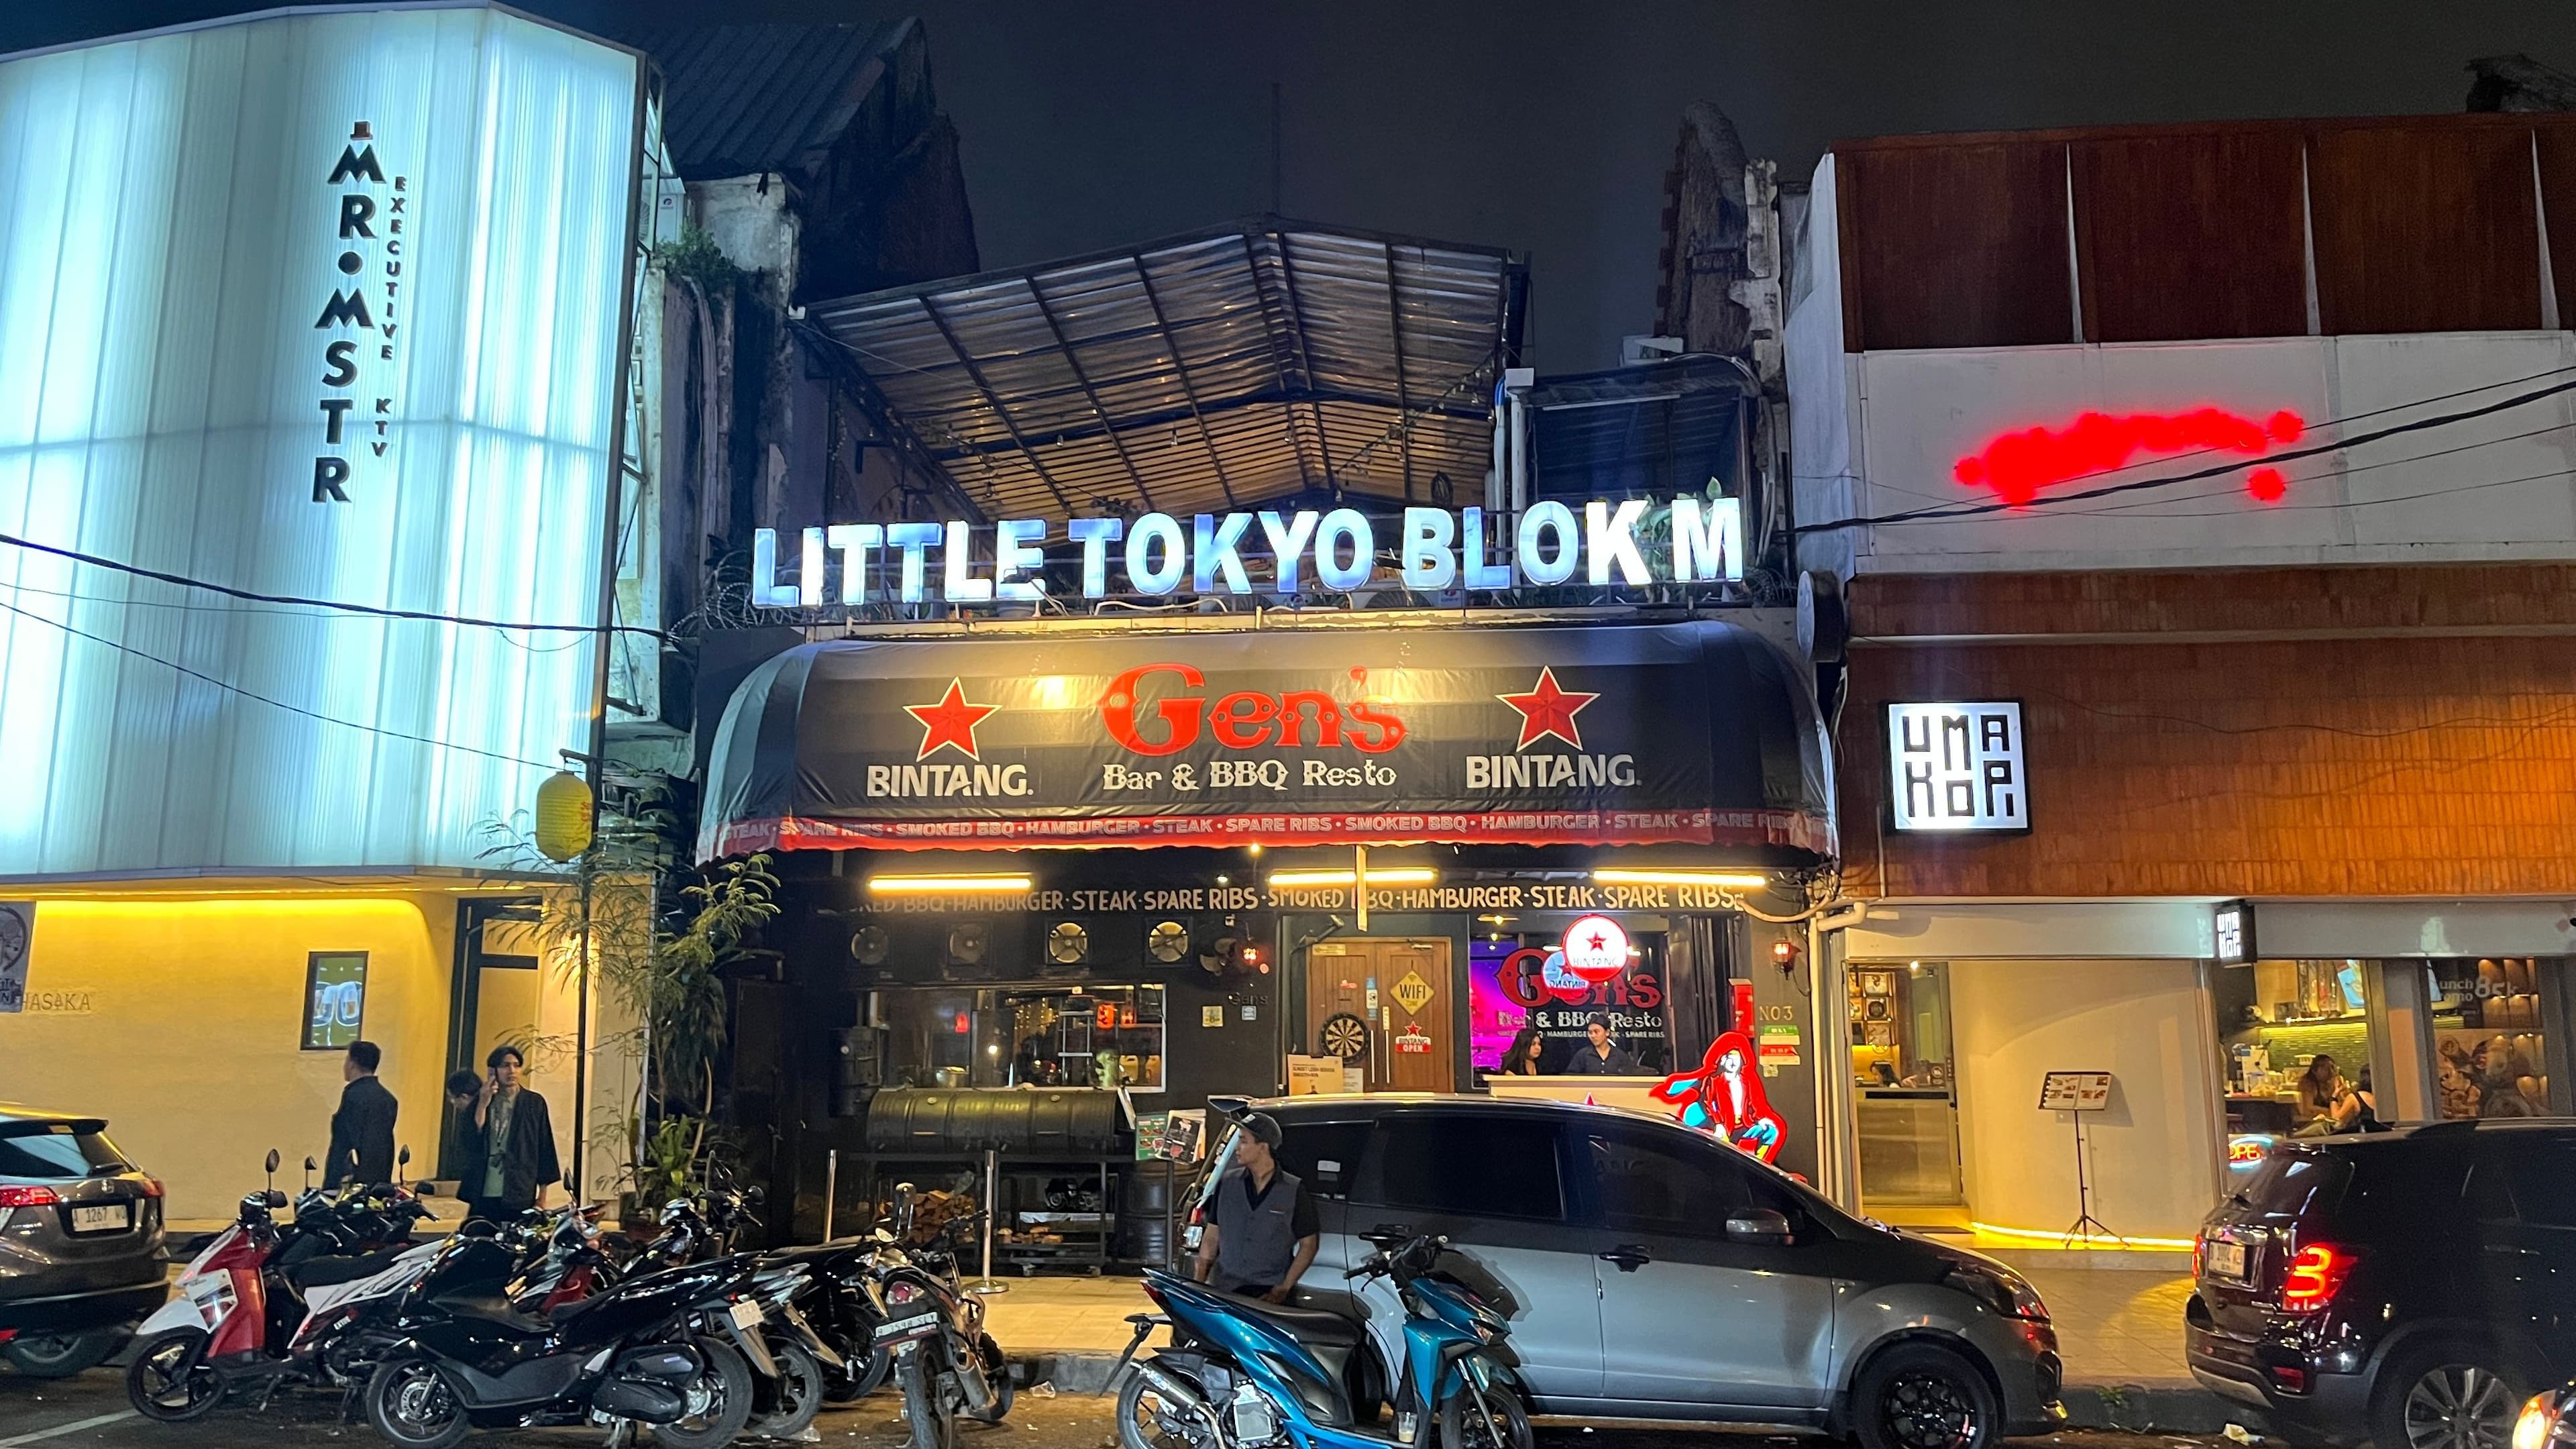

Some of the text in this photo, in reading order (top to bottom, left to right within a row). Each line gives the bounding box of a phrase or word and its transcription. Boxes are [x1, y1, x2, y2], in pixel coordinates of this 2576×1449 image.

[371, 175, 407, 457] EXECUTIVE KTV
[751, 497, 1743, 608] LITTLE TOKYO BLOK M
[1097, 662, 1409, 757] Gen's
[1902, 714, 2010, 771] UMA
[1103, 759, 1397, 792] Bar & BBQ Resto
[779, 821, 839, 837] SPARE
[841, 822, 883, 837] RIBS
[895, 822, 973, 838] SMOKED
[976, 822, 1015, 839] BBQ
[1026, 819, 1141, 836] HAMBURGER
[1152, 818, 1214, 835] STEAK
[1225, 817, 1286, 833] SPARE
[1289, 817, 1333, 833] RIBS
[1344, 816, 1424, 832] SMOKED
[1428, 815, 1468, 834] BBQ
[1481, 814, 1601, 830] HAMBURGER
[1614, 813, 1679, 829] STEAK
[1692, 812, 1754, 828] SPARE
[953, 890, 1064, 912] HAMBURGER
[1072, 890, 1138, 911] STEAK
[1143, 888, 1205, 910] SPARE
[1208, 887, 1259, 910] RIBS
[1268, 887, 1345, 908] SMOKED
[1401, 885, 1525, 909] HAMBURGER
[1529, 885, 1597, 908] STEAK
[1604, 884, 1670, 910] SPARE
[1678, 884, 1735, 909] RIBS
[1399, 983, 1426, 1000] WIFI
[2439, 977, 2475, 990] unch
[1536, 1011, 1553, 1028] &
[1610, 1011, 1663, 1028] Resto
[1547, 1030, 1589, 1038] HAMBURGE
[1625, 1030, 1648, 1038] SPARE
[1648, 1030, 1666, 1038] RIBS
[1402, 1044, 1424, 1053] OPEN
